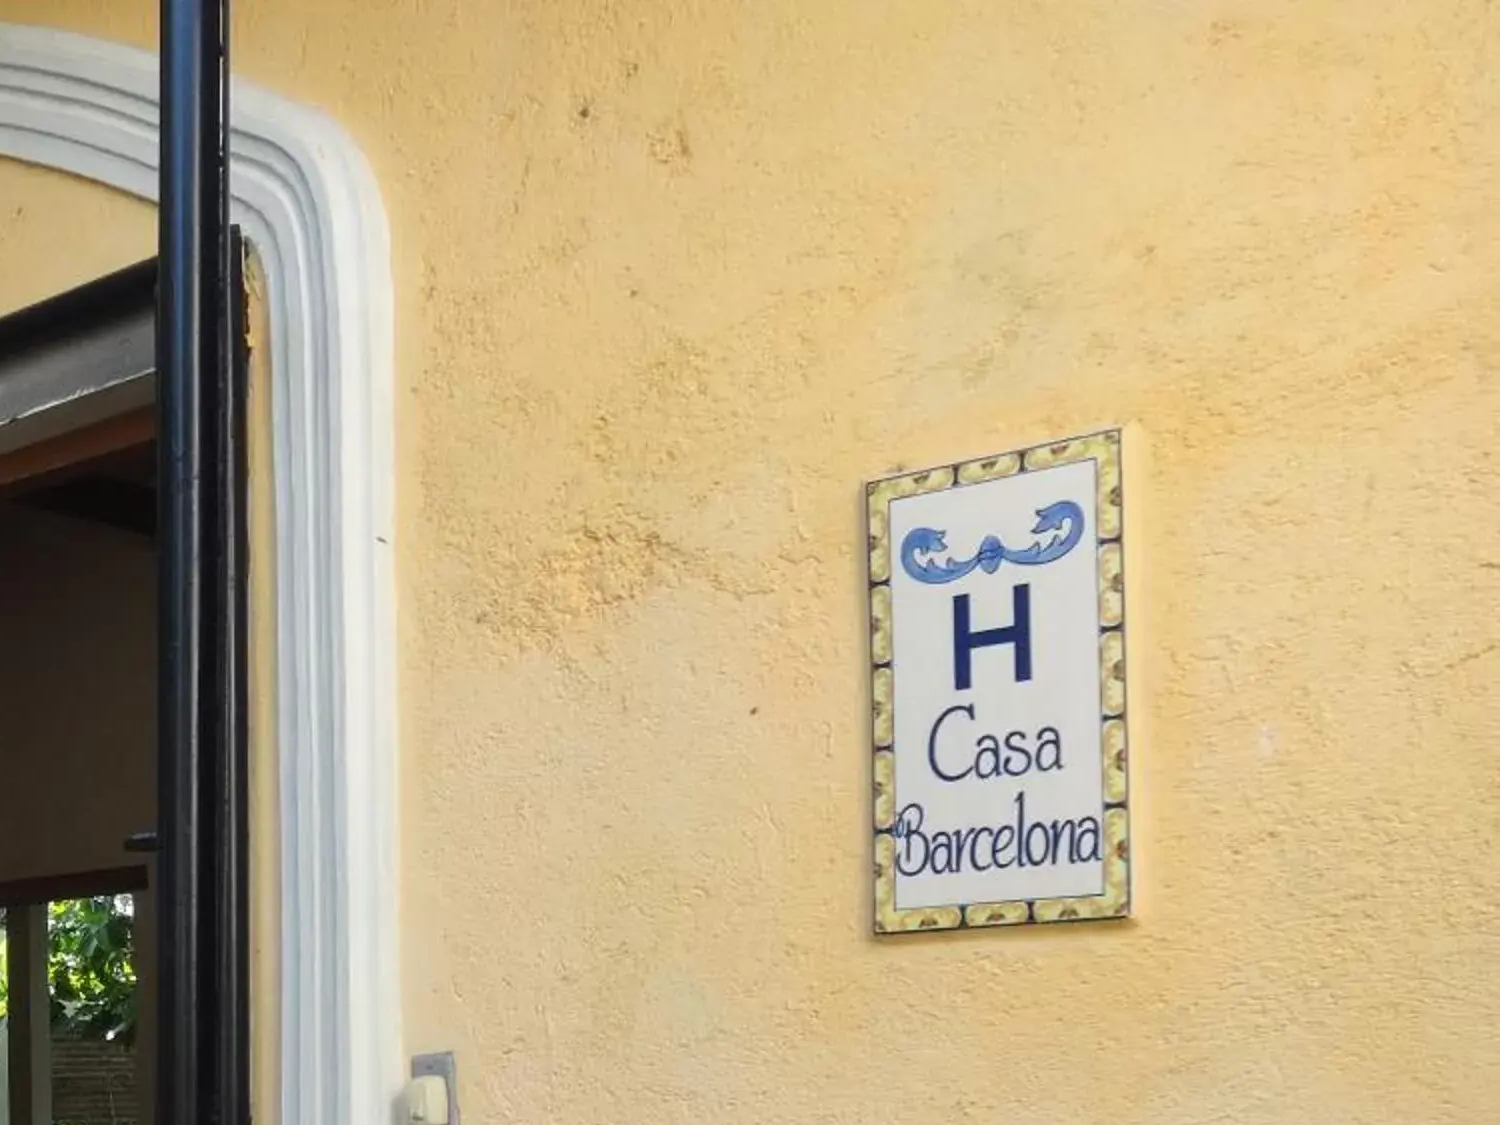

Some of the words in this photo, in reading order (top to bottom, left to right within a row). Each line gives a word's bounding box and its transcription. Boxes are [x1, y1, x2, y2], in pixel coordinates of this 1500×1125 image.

[953, 583, 1032, 691] H
[928, 703, 1064, 782] Casa
[896, 791, 1103, 877] Barcelona
